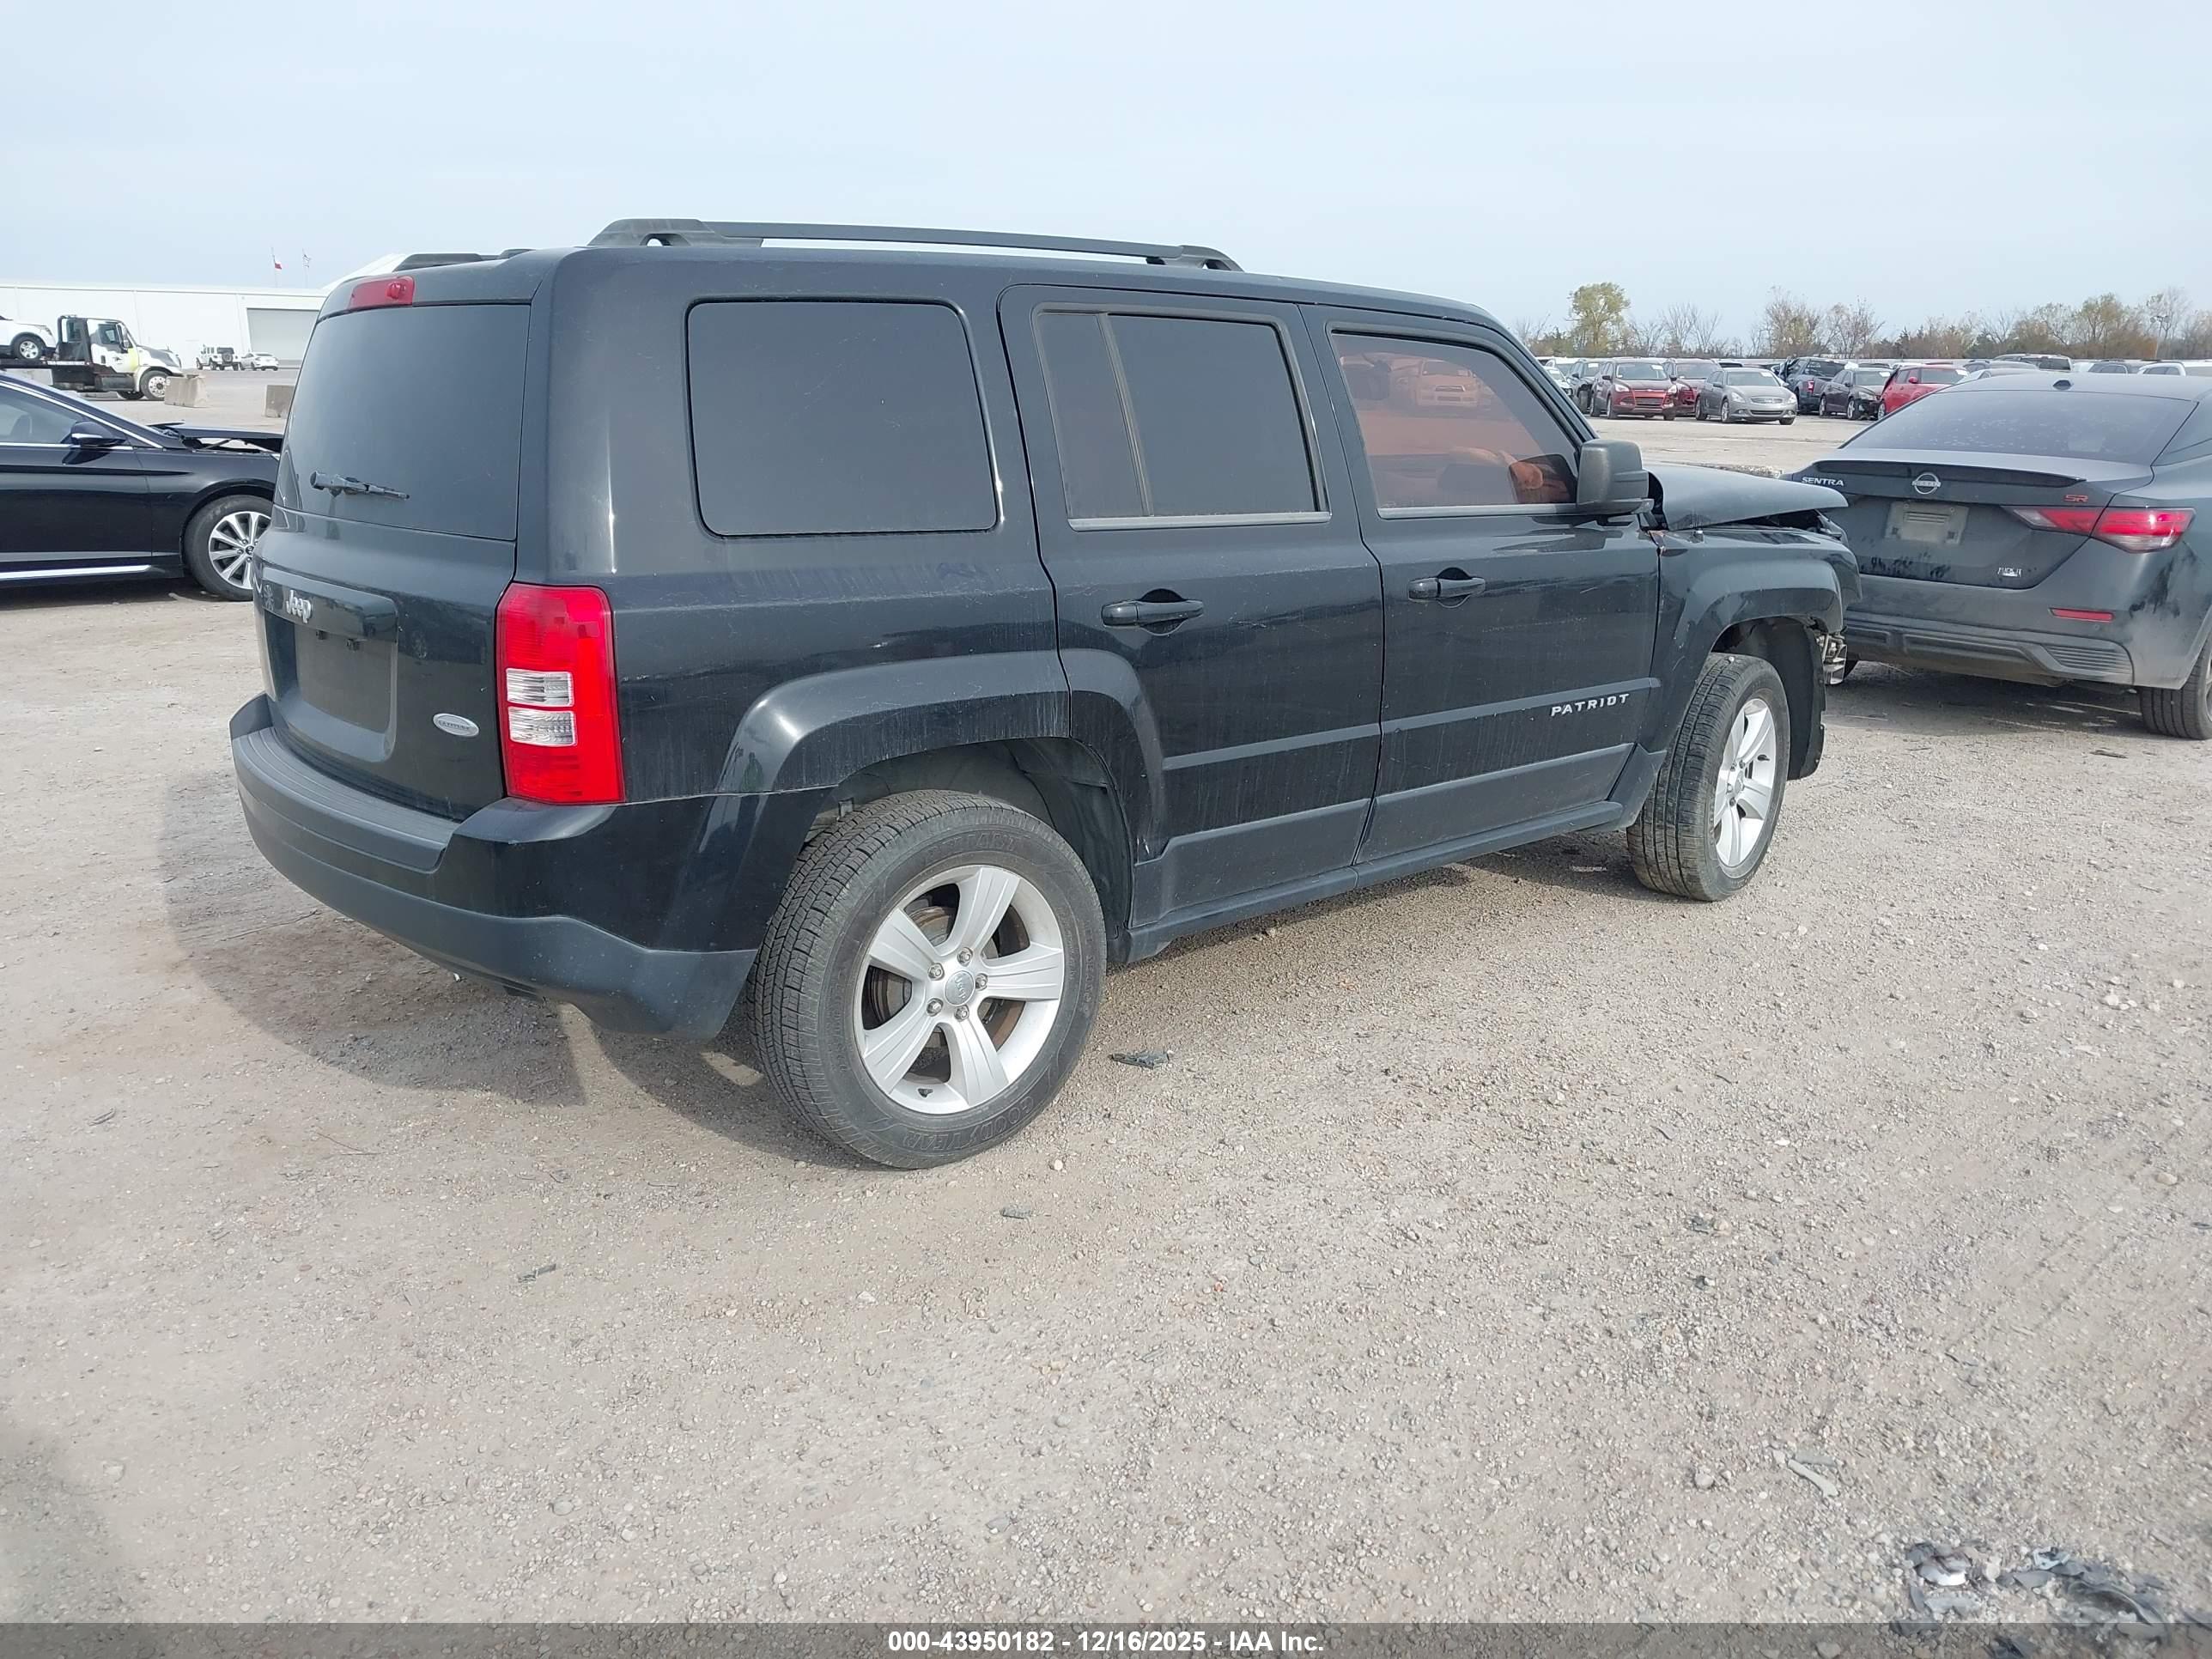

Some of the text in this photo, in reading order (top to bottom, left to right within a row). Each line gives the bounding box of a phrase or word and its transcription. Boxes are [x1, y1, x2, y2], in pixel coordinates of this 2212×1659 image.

[1802, 477, 1844, 487] SENTRA
[286, 589, 312, 623] Jeep
[1551, 693, 1630, 717] PATRIOT
